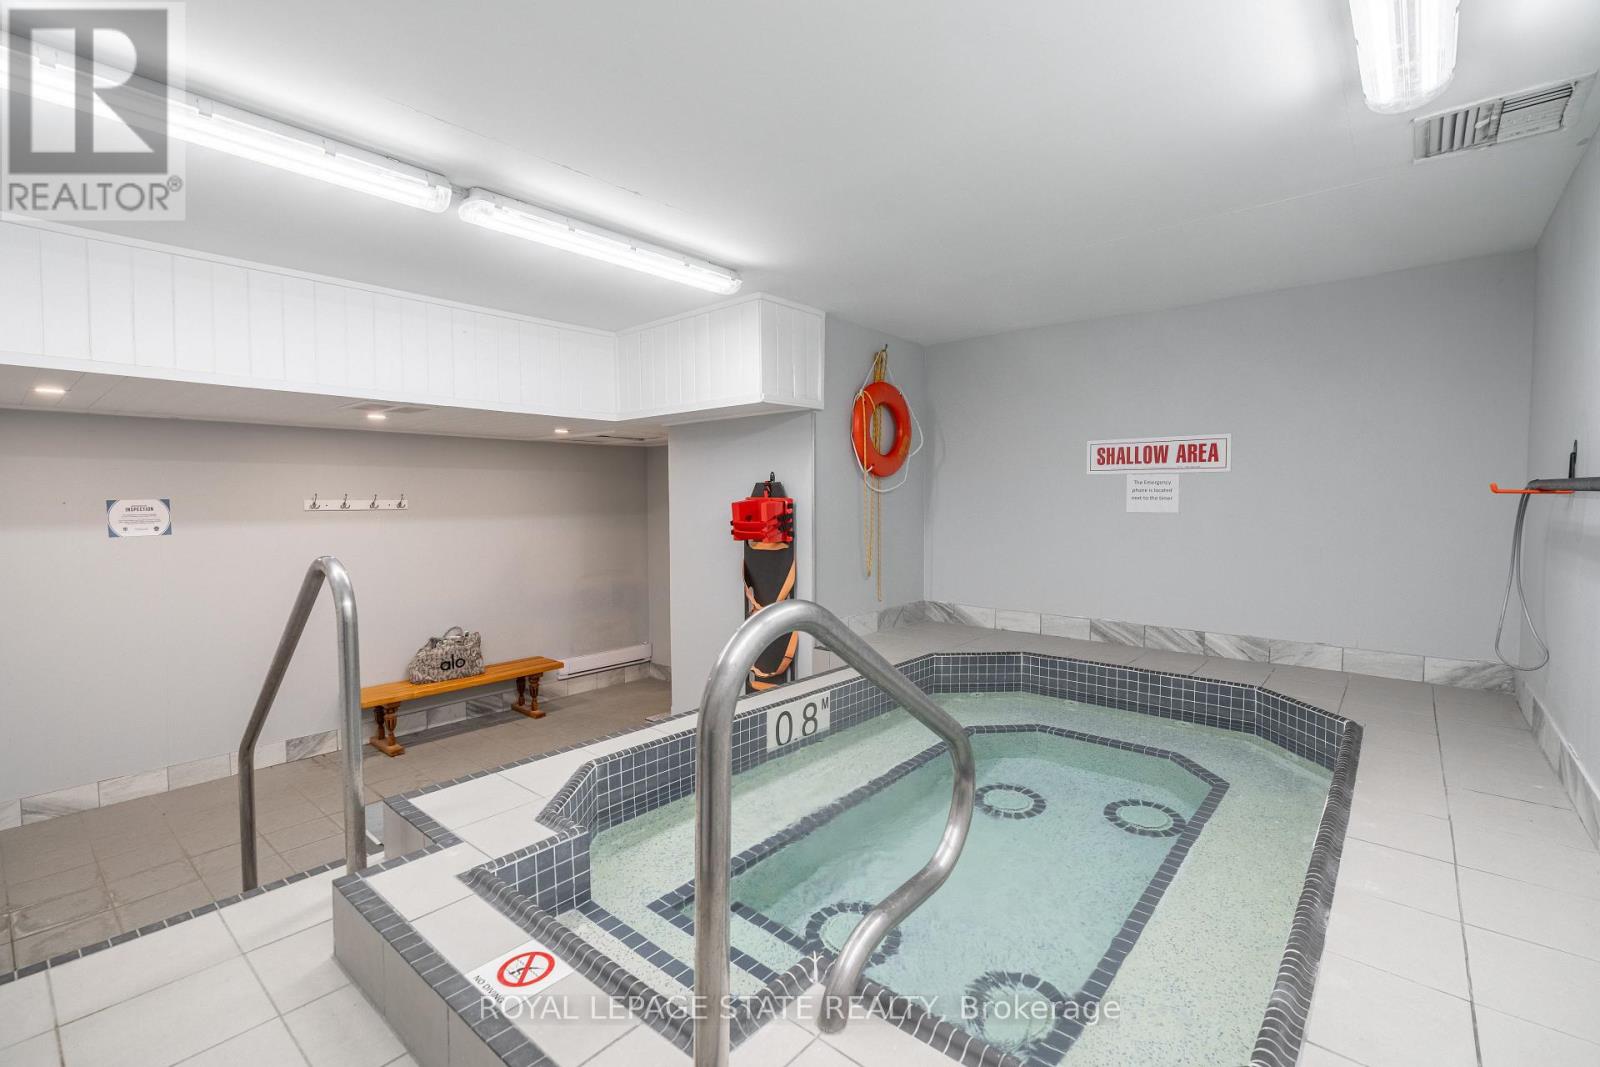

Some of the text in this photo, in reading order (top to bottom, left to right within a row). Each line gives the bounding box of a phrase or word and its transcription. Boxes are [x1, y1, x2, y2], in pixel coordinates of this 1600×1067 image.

[1097, 443, 1219, 465] SHALLOW AREA
[440, 653, 466, 671] alo
[821, 696, 829, 711] M
[473, 975, 505, 1004] NO DIVING
